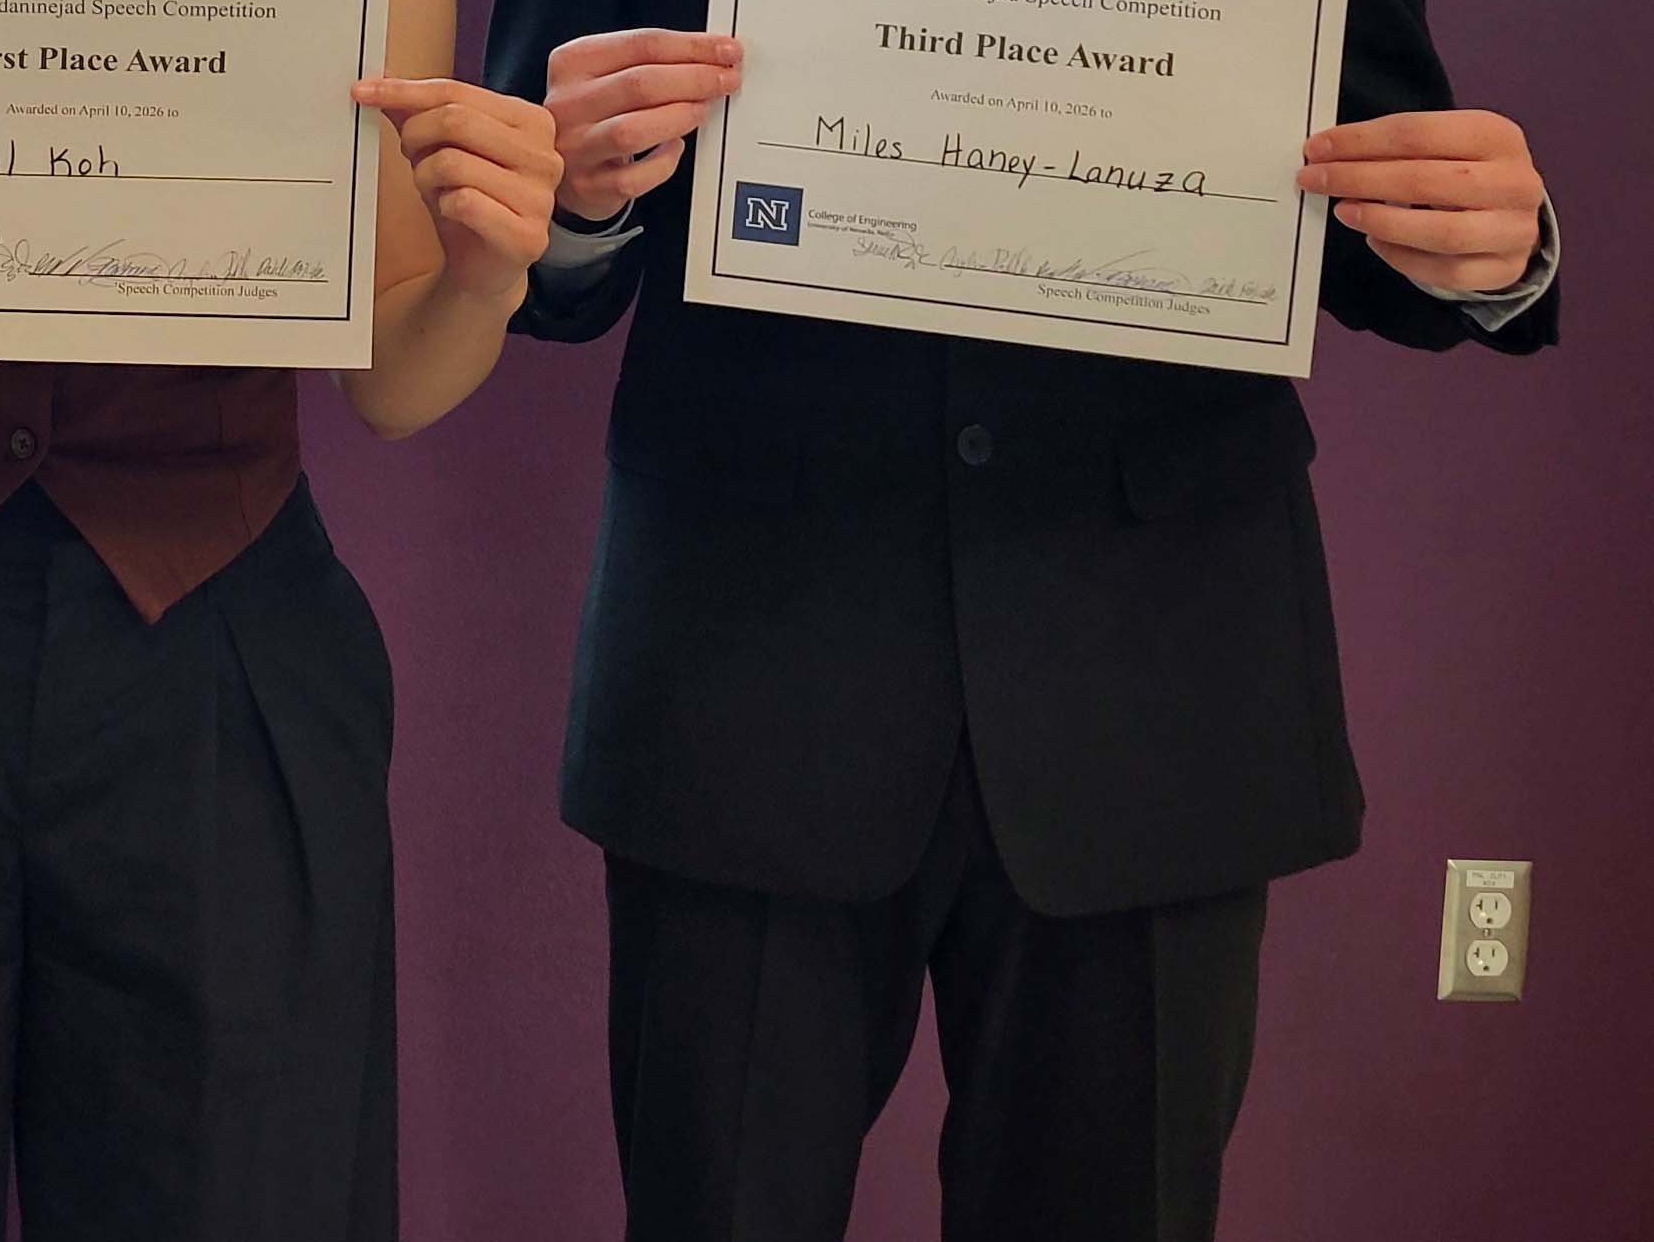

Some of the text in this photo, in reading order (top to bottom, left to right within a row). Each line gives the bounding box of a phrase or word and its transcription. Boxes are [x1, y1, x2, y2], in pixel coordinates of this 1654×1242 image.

[91, 0, 158, 18] Speech
[162, 0, 278, 22] Competition
[39, 47, 119, 74] Place
[126, 50, 227, 75] Award
[874, 23, 1176, 78] Third Place Award
[6, 103, 180, 120] Awarded on April 10, 2026 to
[930, 89, 1113, 118] Awarded on April 10, 2026 to
[48, 144, 121, 177] Koh
[814, 115, 1207, 197] Miles Haney-Lanuza
[745, 196, 789, 231] N
[808, 209, 917, 233] College of Engineering
[117, 282, 278, 300] Speech Competition Judges
[1037, 284, 1211, 317] Speech Competition Judges
